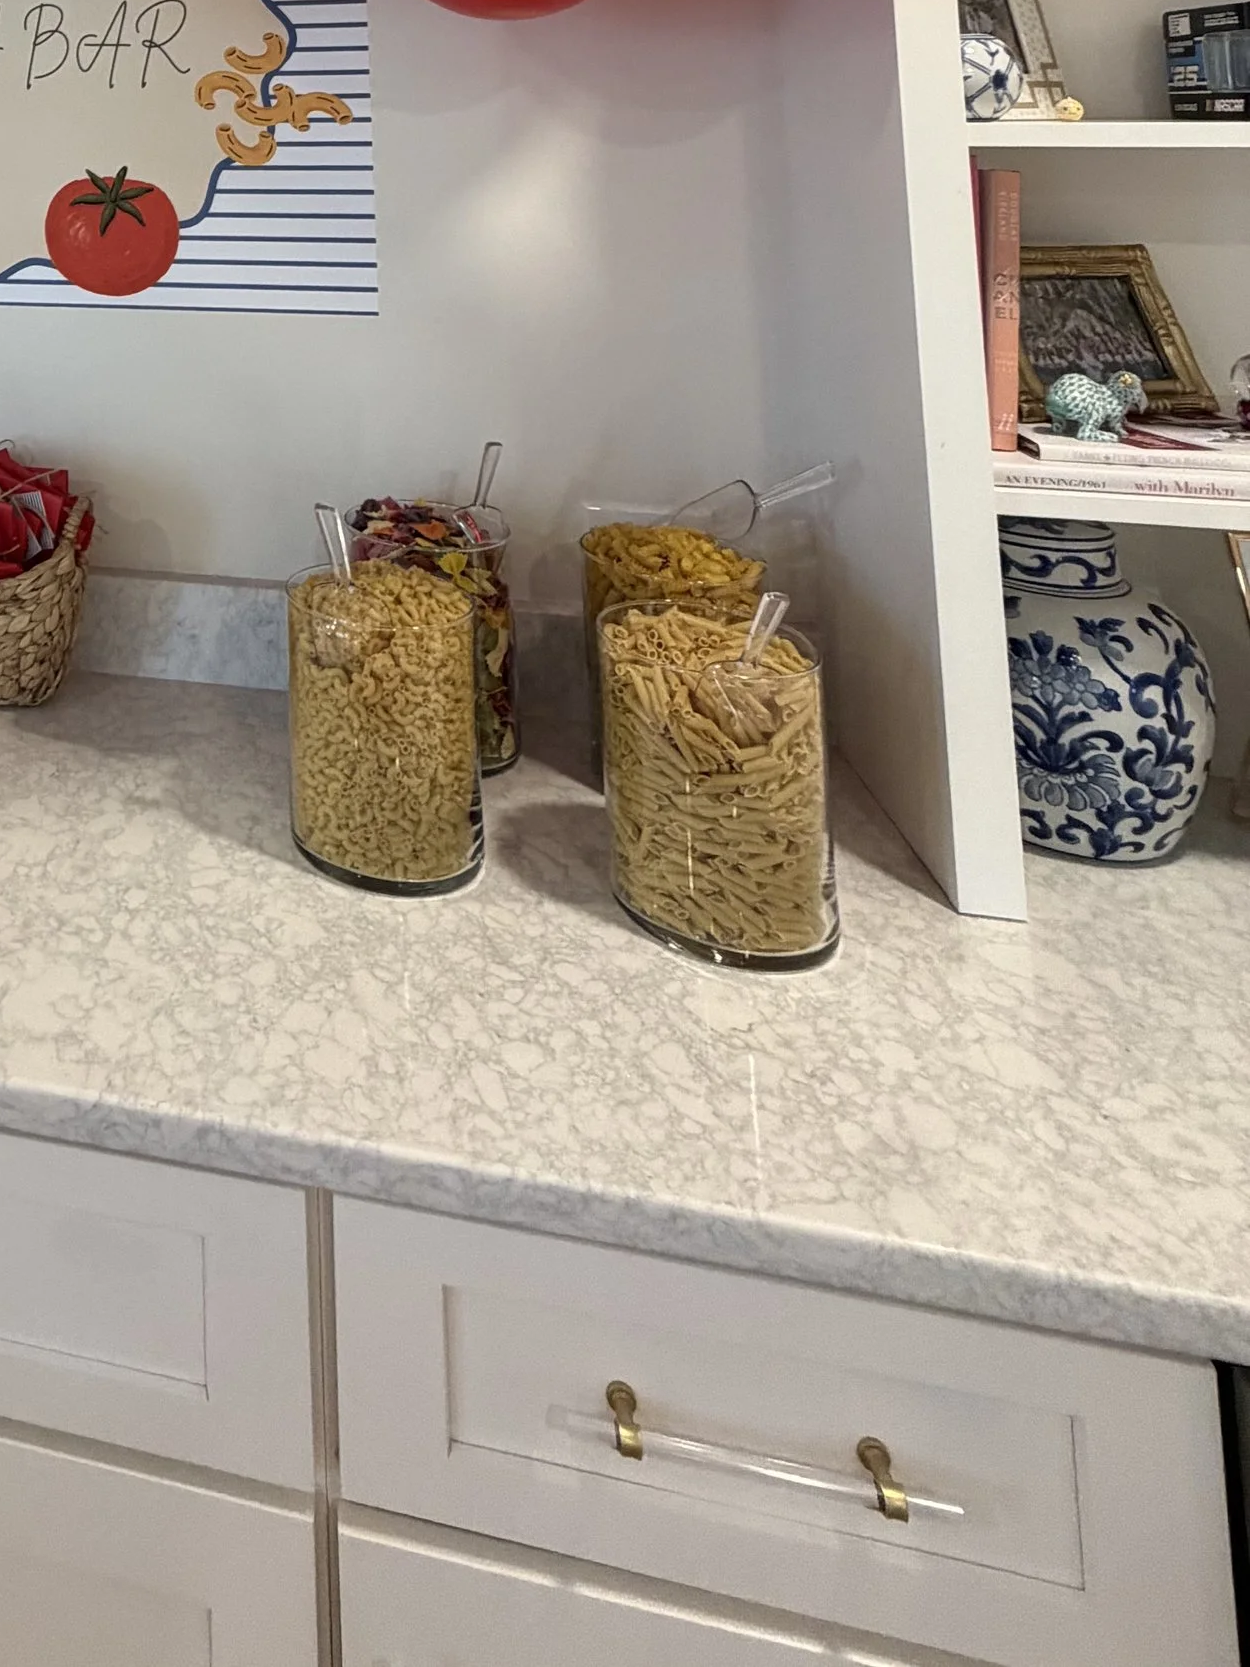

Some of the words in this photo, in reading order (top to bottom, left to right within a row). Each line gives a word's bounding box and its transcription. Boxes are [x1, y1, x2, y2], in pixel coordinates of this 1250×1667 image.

[24, 0, 191, 90] BAR
[1004, 475, 1021, 484] AN
[1134, 480, 1169, 494] with
[1173, 481, 1236, 498] Marilyn
